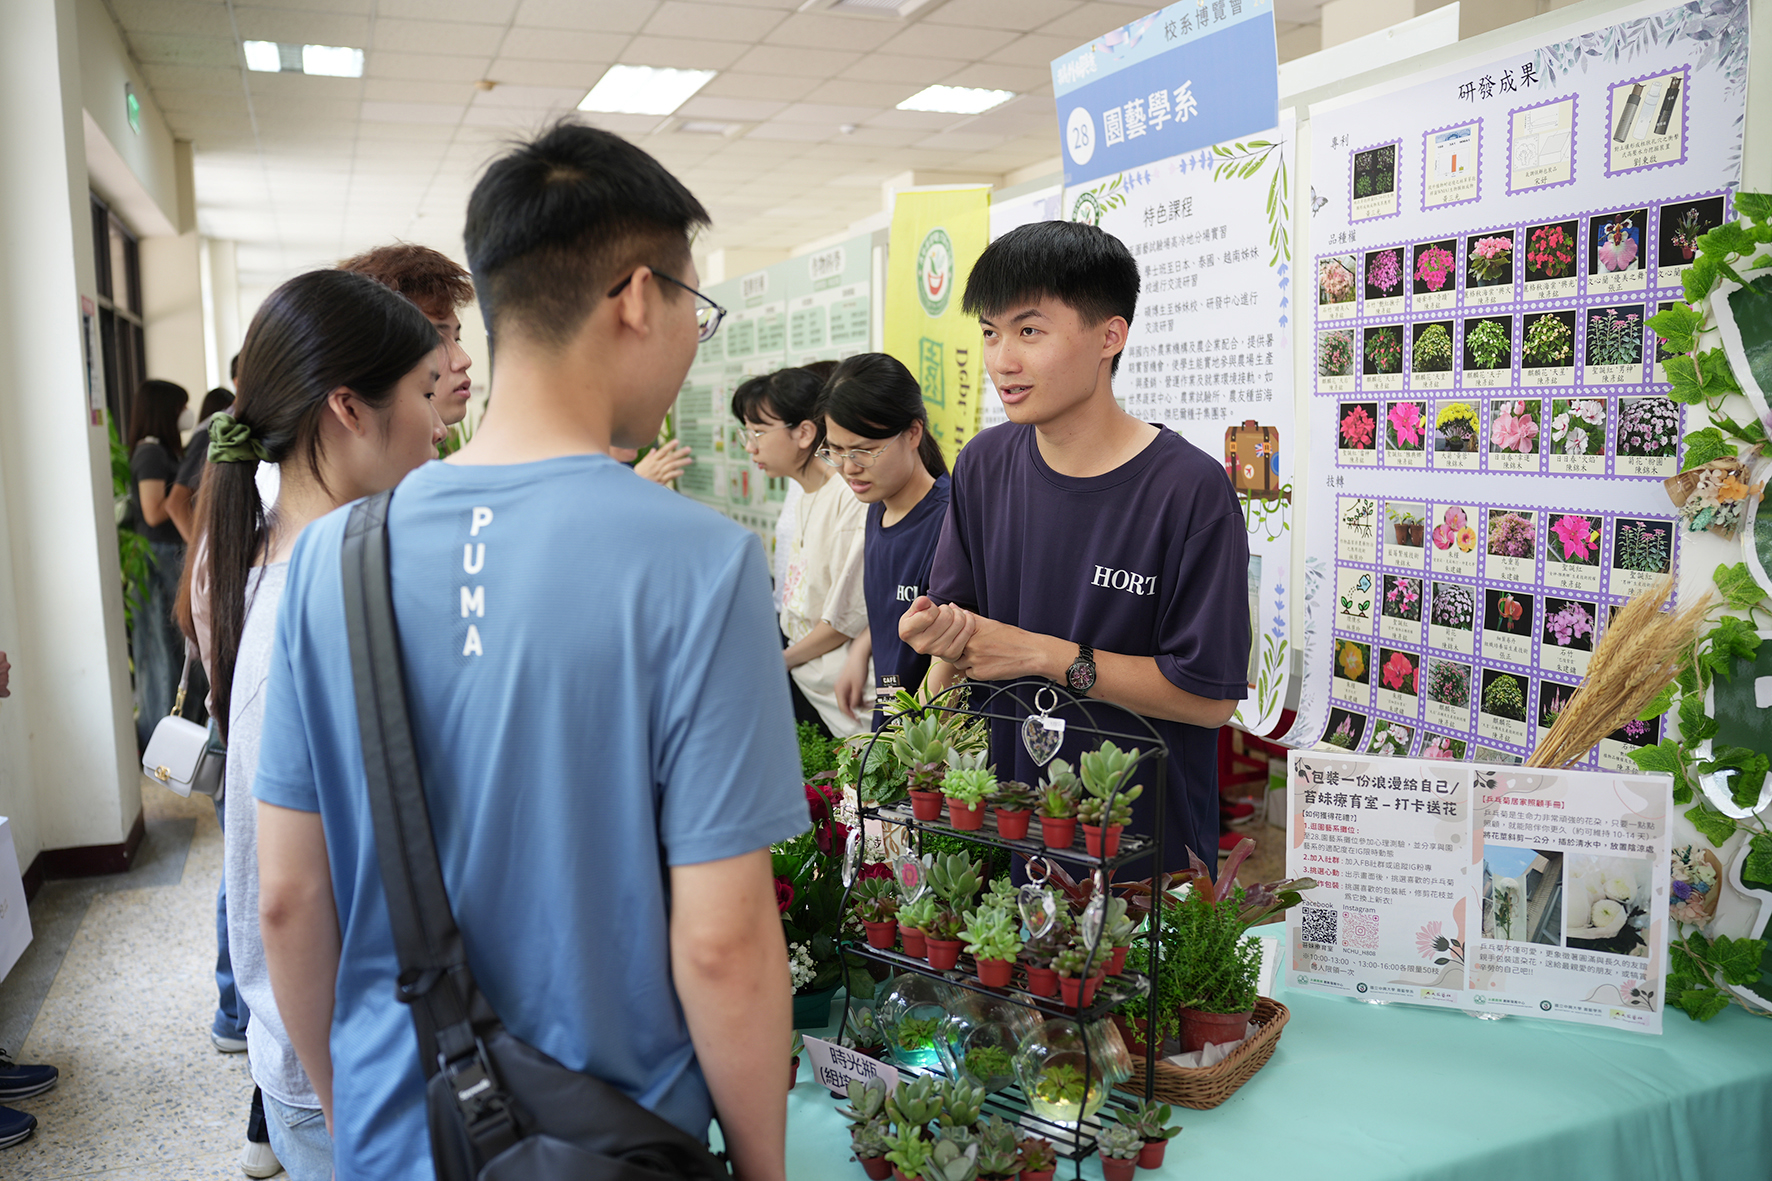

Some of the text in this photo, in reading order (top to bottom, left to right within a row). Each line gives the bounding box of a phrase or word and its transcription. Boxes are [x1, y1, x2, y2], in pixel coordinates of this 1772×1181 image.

[1164, 0, 1243, 42] 校系博覽會
[1457, 61, 1539, 103] 研發成果
[1102, 80, 1199, 148] 園藝學系
[1073, 123, 1089, 149] 28
[1329, 133, 1350, 150] 專利
[1144, 196, 1193, 228] 特色課程
[1328, 229, 1357, 246] 品種權
[1145, 319, 1174, 334] 交流研習
[1326, 475, 1345, 488] 技轉
[460, 506, 494, 657] PUMA
[1090, 564, 1157, 596] HORT
[1560, 649, 1574, 658] 石竹
[1311, 770, 1460, 795] 包裝一份浪漫給自己/
[1304, 790, 1379, 810] 苔妹療育室
[1395, 797, 1457, 816] 打卡送花
[1303, 900, 1334, 909] Facebook
[1342, 904, 1376, 913] Instagram
[829, 1047, 878, 1079] 時光瓶
